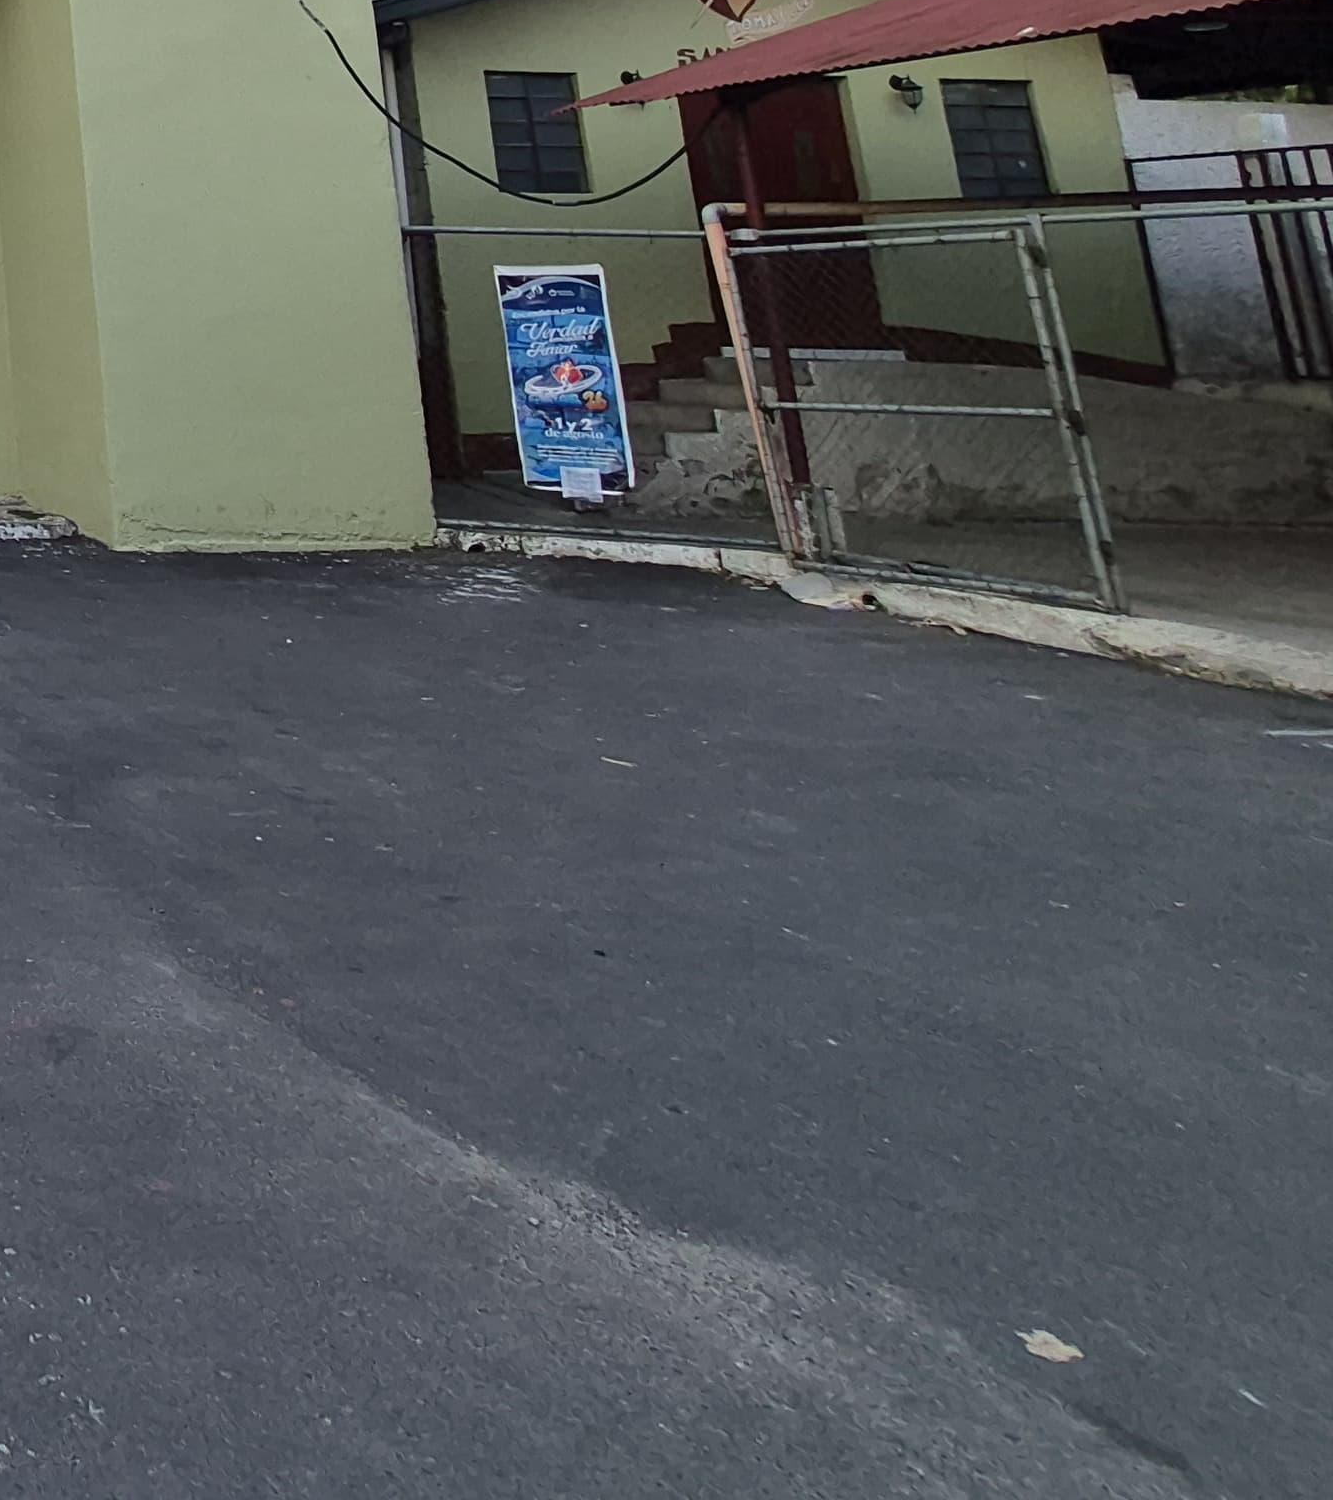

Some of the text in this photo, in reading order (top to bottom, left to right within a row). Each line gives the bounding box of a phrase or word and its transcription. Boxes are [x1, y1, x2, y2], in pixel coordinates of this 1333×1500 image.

[520, 317, 601, 341] Verdad
[554, 417, 593, 434] 1 y 2
